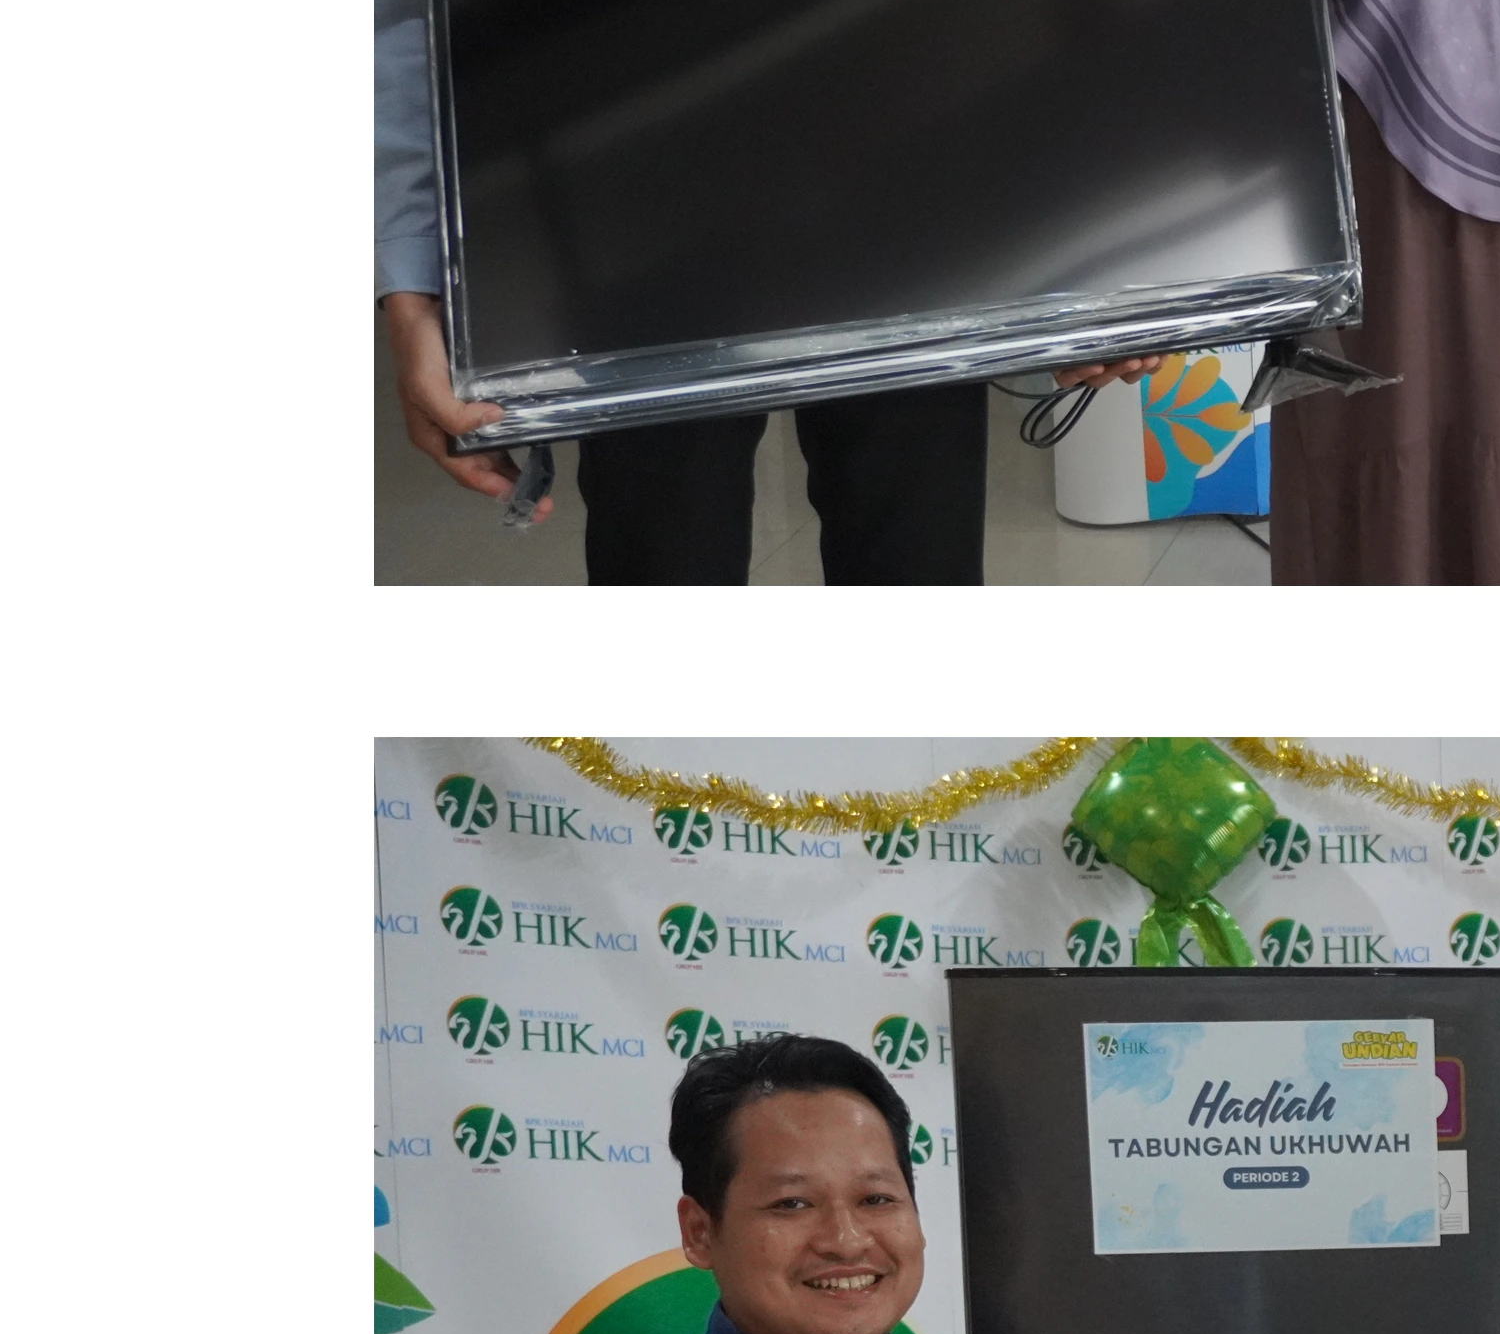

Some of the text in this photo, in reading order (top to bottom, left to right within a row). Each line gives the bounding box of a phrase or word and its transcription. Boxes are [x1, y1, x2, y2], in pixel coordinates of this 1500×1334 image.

[508, 801, 632, 844] HIK MCI
[1320, 835, 1427, 864] HIK MCI
[728, 927, 845, 962] HIK MCI
[521, 1020, 645, 1057] HIK MCI
[1123, 1042, 1150, 1054] HIK
[1342, 1041, 1418, 1060] UNDIAN
[1353, 1031, 1406, 1043] GEBYAR
[1188, 1080, 1337, 1129] Hadiah
[528, 1129, 650, 1163] HIK MCI
[1108, 1133, 1411, 1158] TABUNGAN UKHUWAH
[1233, 1172, 1300, 1184] PERIODE 2
